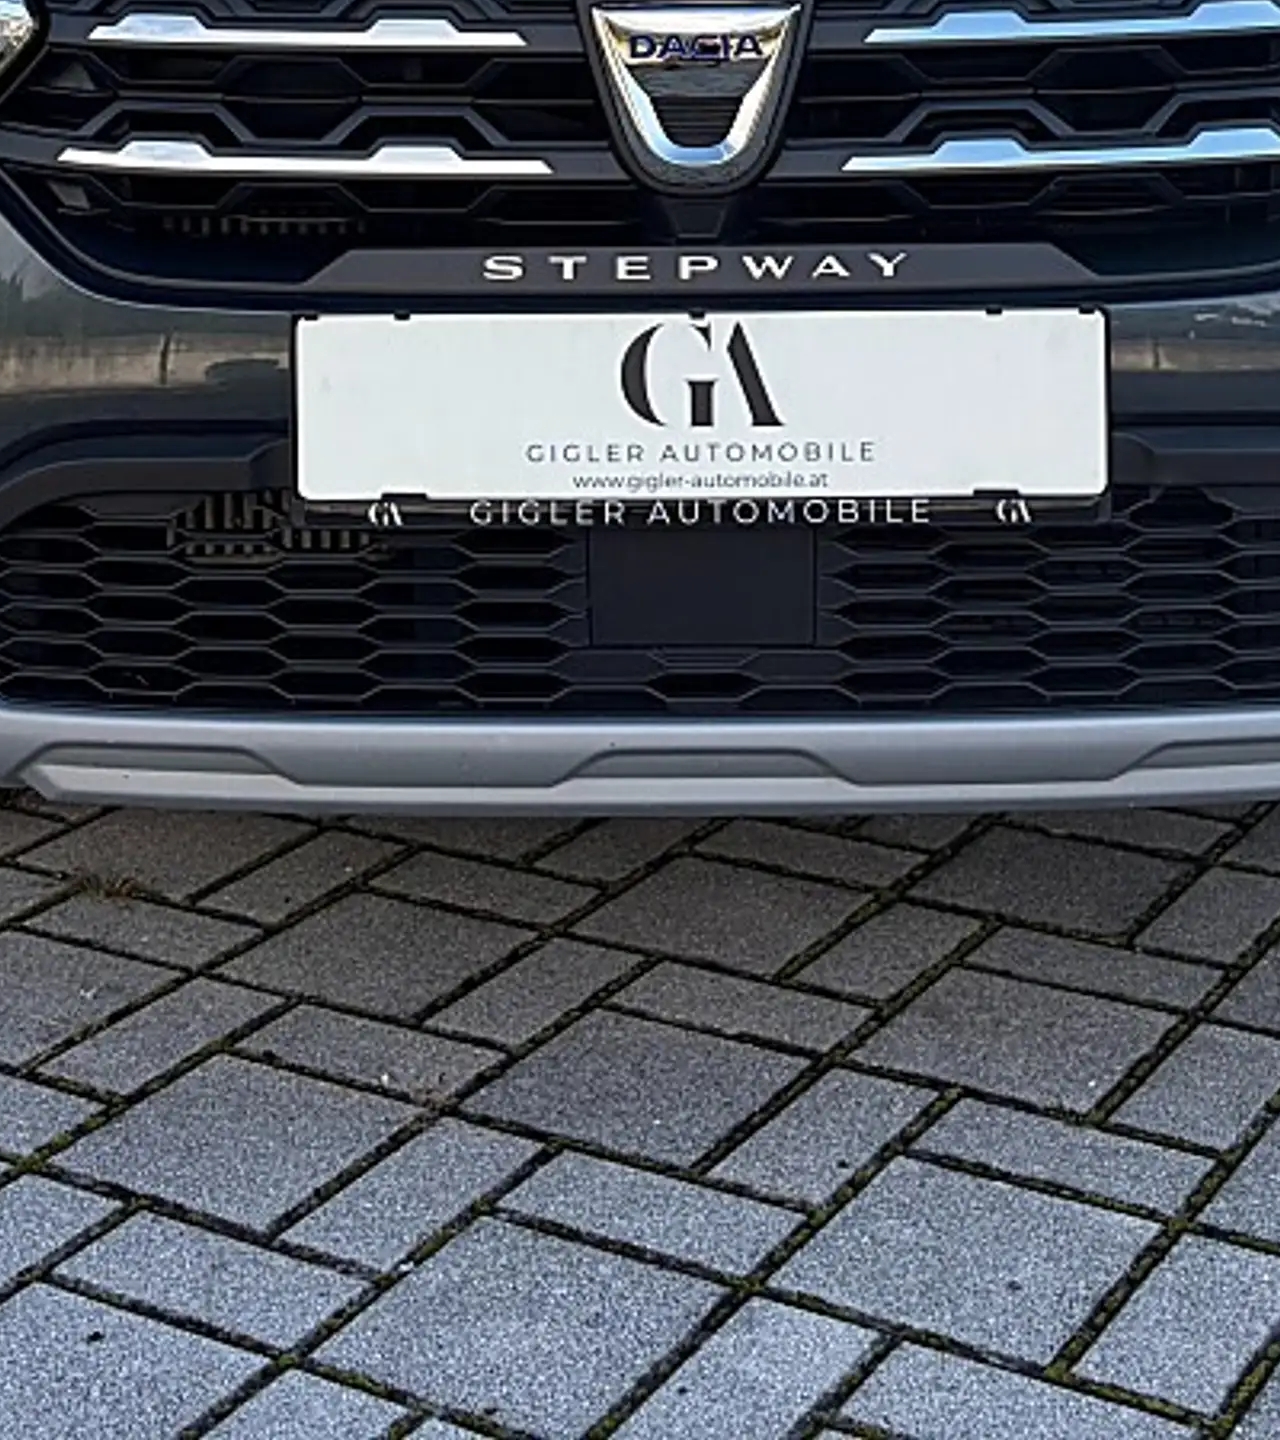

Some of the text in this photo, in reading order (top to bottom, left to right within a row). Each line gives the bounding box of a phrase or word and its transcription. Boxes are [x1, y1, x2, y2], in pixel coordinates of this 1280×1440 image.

[629, 34, 762, 59] DACIA
[482, 251, 908, 281] STEPWAY
[525, 441, 876, 463] GIGLER AUTOMOBILE
[572, 470, 829, 493] www.gigler-automobile.at
[470, 500, 626, 526] GIGLER
[646, 498, 931, 525] AUTOMOBILE
